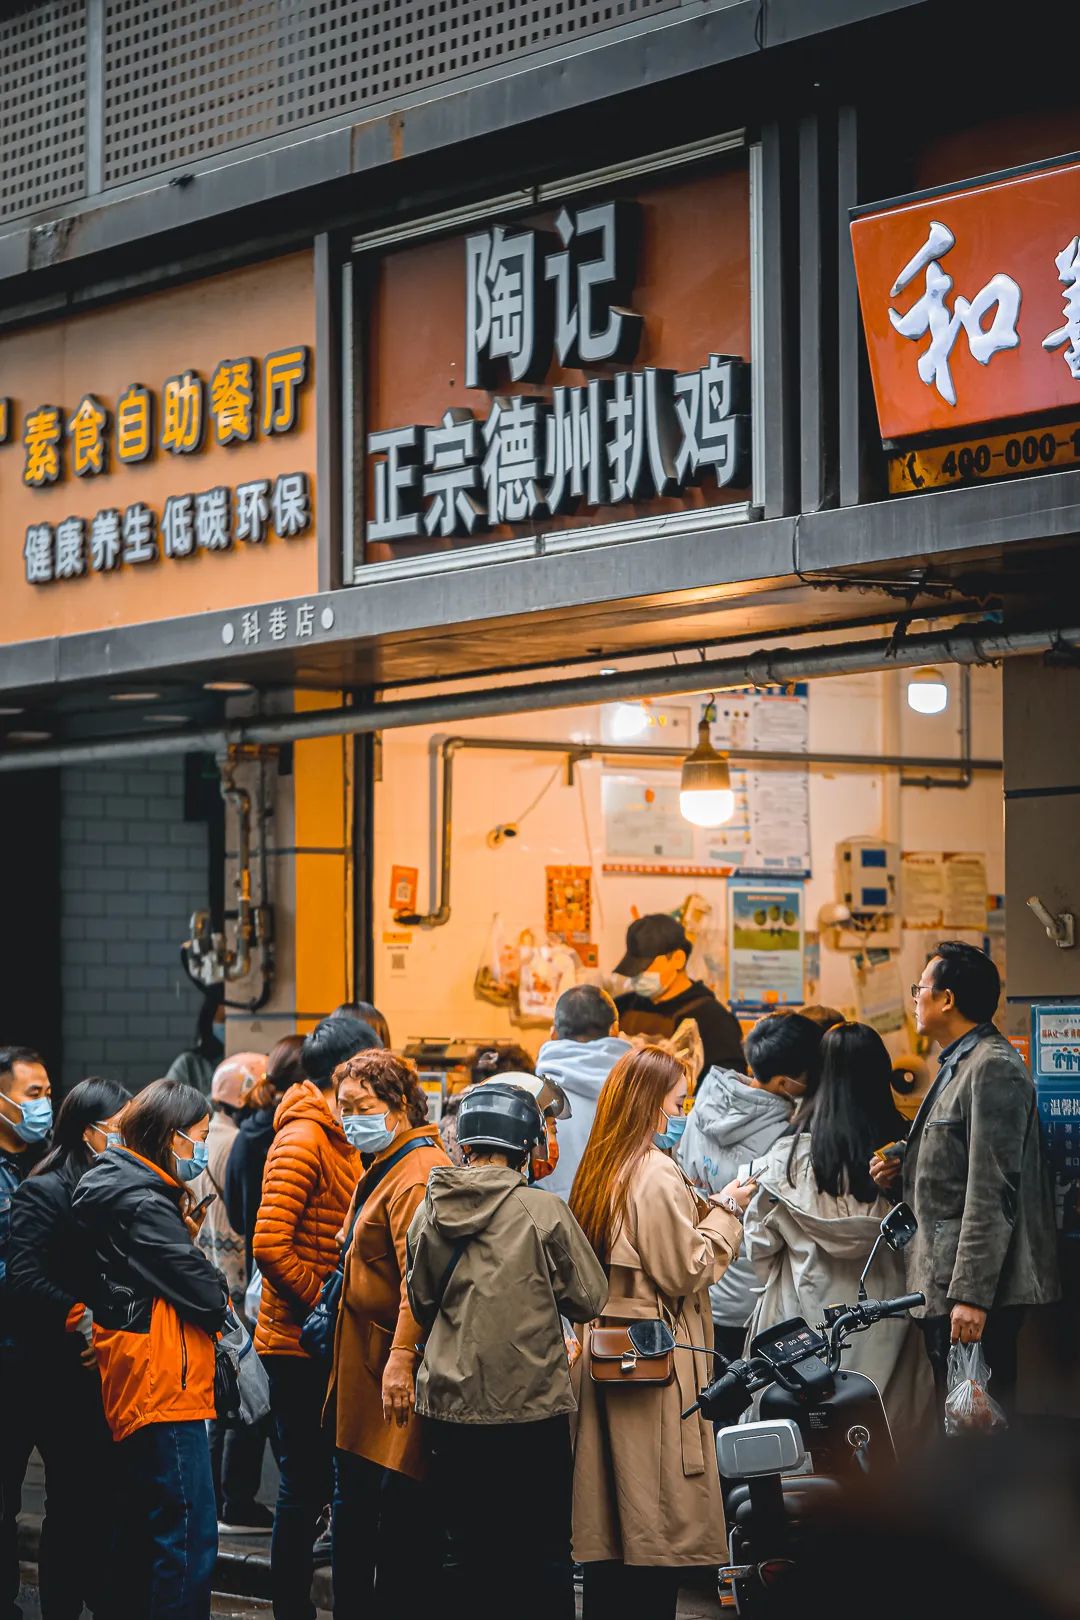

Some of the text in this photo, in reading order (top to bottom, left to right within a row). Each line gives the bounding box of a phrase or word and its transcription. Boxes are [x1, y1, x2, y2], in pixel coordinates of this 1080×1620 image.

[465, 201, 625, 388] 陶记
[0, 346, 310, 486] 素食自助餐厅
[367, 354, 741, 542] 正宗德州扒鸡
[242, 603, 315, 645] 科巷店
